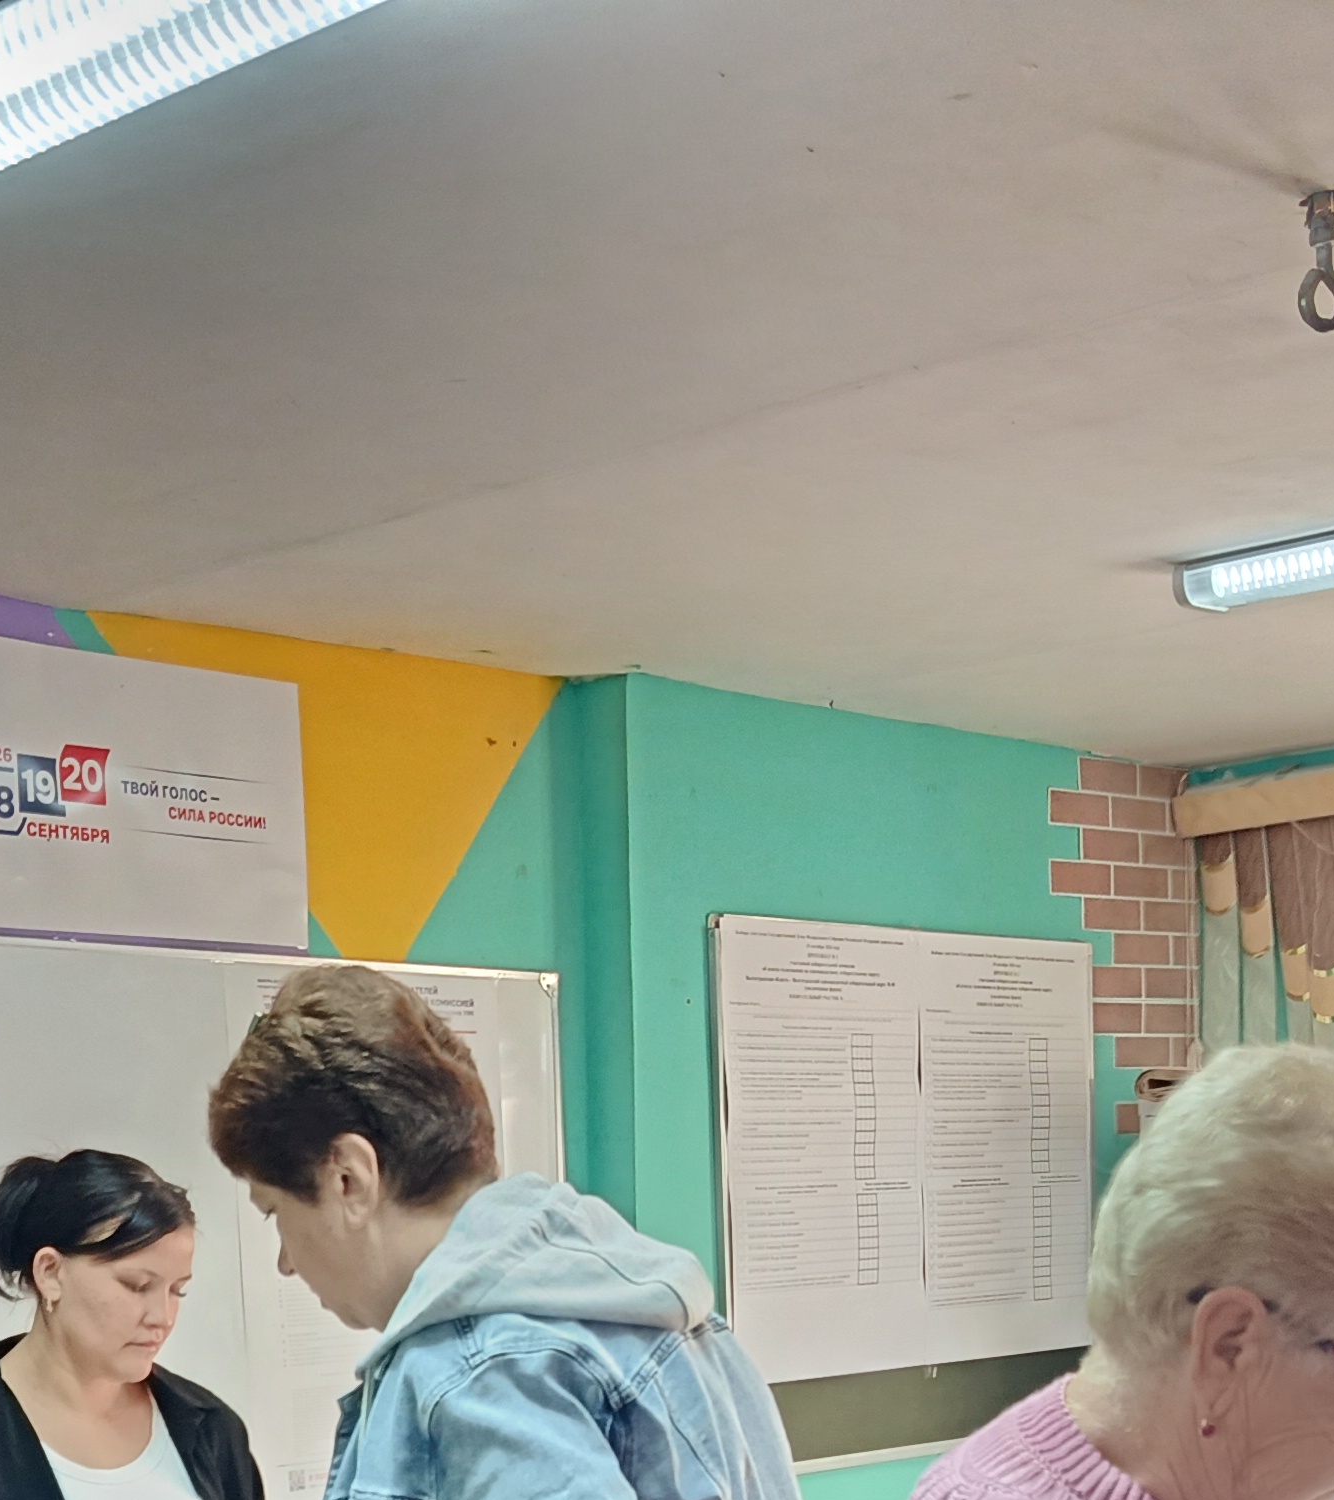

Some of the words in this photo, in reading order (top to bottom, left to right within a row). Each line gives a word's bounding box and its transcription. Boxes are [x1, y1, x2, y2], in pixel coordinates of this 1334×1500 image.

[21, 769, 56, 805] 19
[61, 757, 103, 792] 20
[121, 780, 158, 798] ТВОЙ
[162, 785, 208, 803] ГОЛОС
[168, 806, 205, 823] СИЛА
[209, 811, 267, 829] РОССИИ!
[27, 821, 110, 844] СЕНТЯБРЯ
